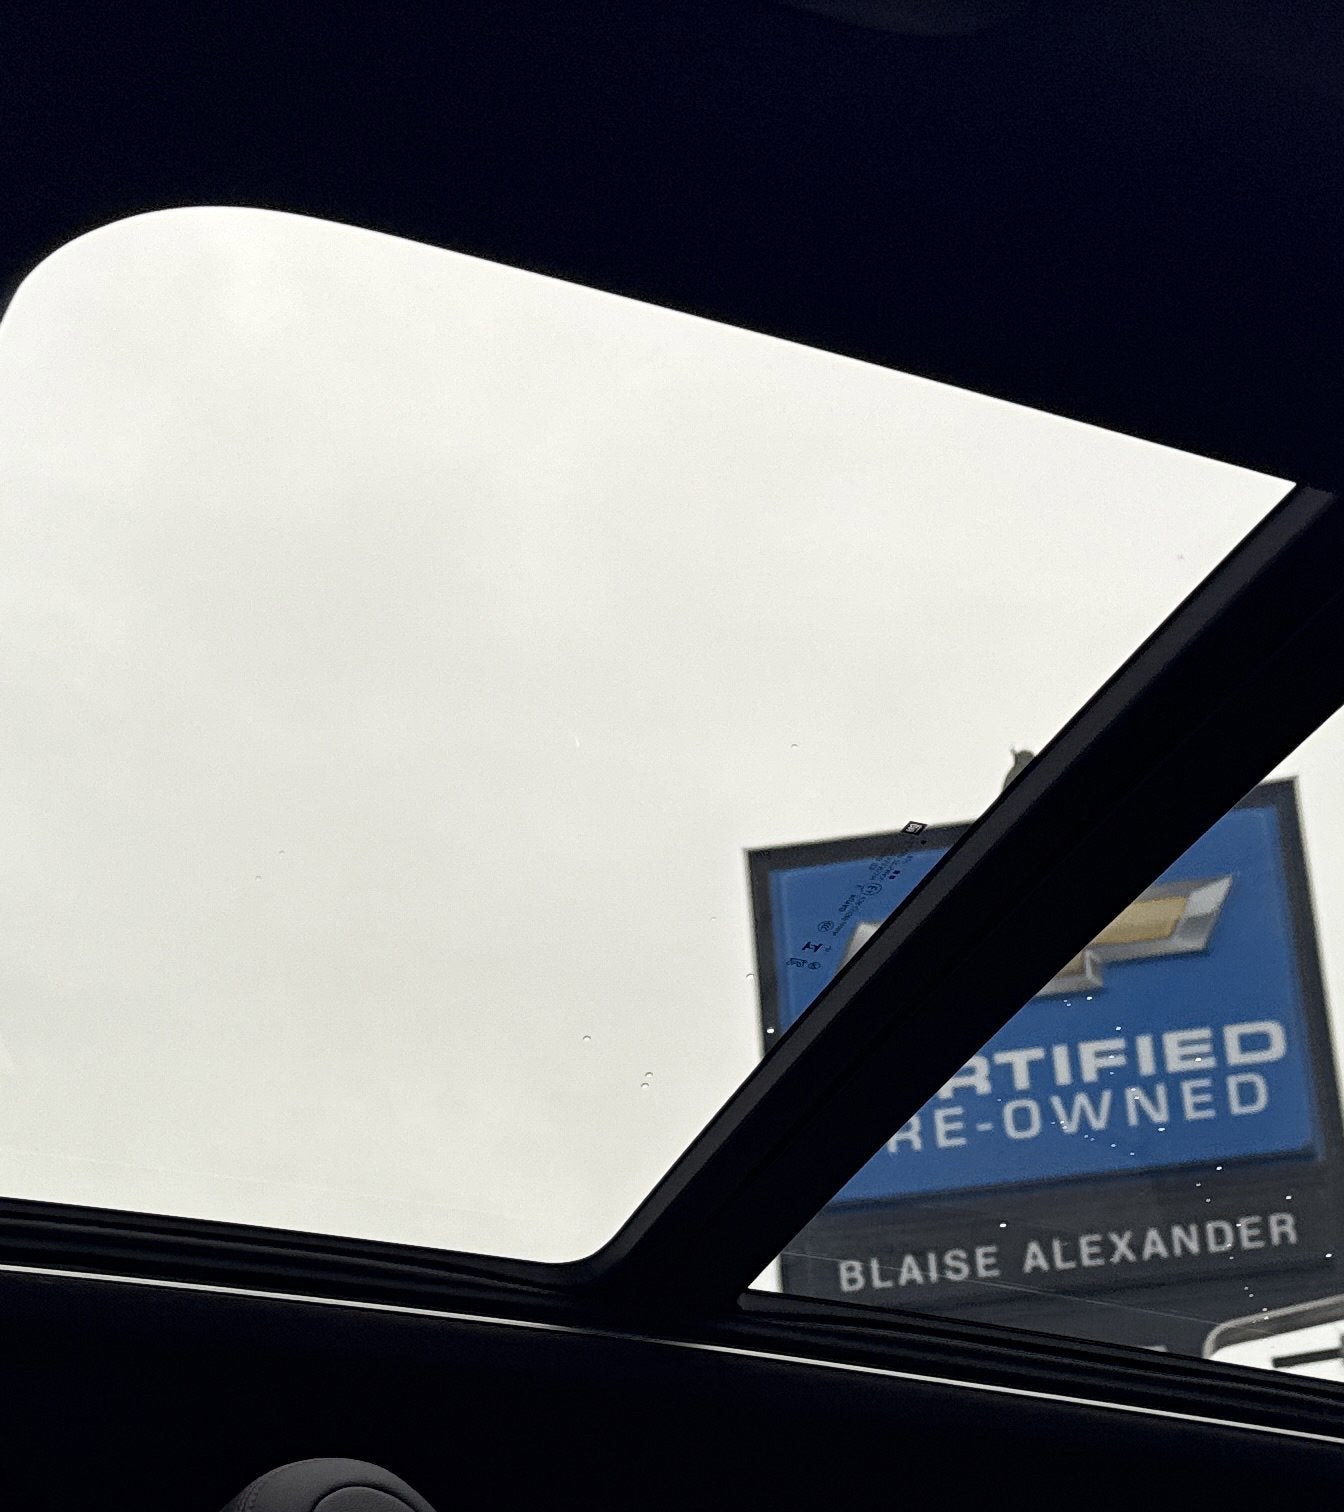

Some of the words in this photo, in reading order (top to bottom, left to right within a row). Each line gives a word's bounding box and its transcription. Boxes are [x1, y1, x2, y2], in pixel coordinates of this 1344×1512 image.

[937, 1020, 1288, 1100] RTIFIED
[886, 1073, 1269, 1154] RE-OWNED
[839, 1245, 1001, 1293] BLAISE
[1022, 1212, 1298, 1274] ALEXANDER
